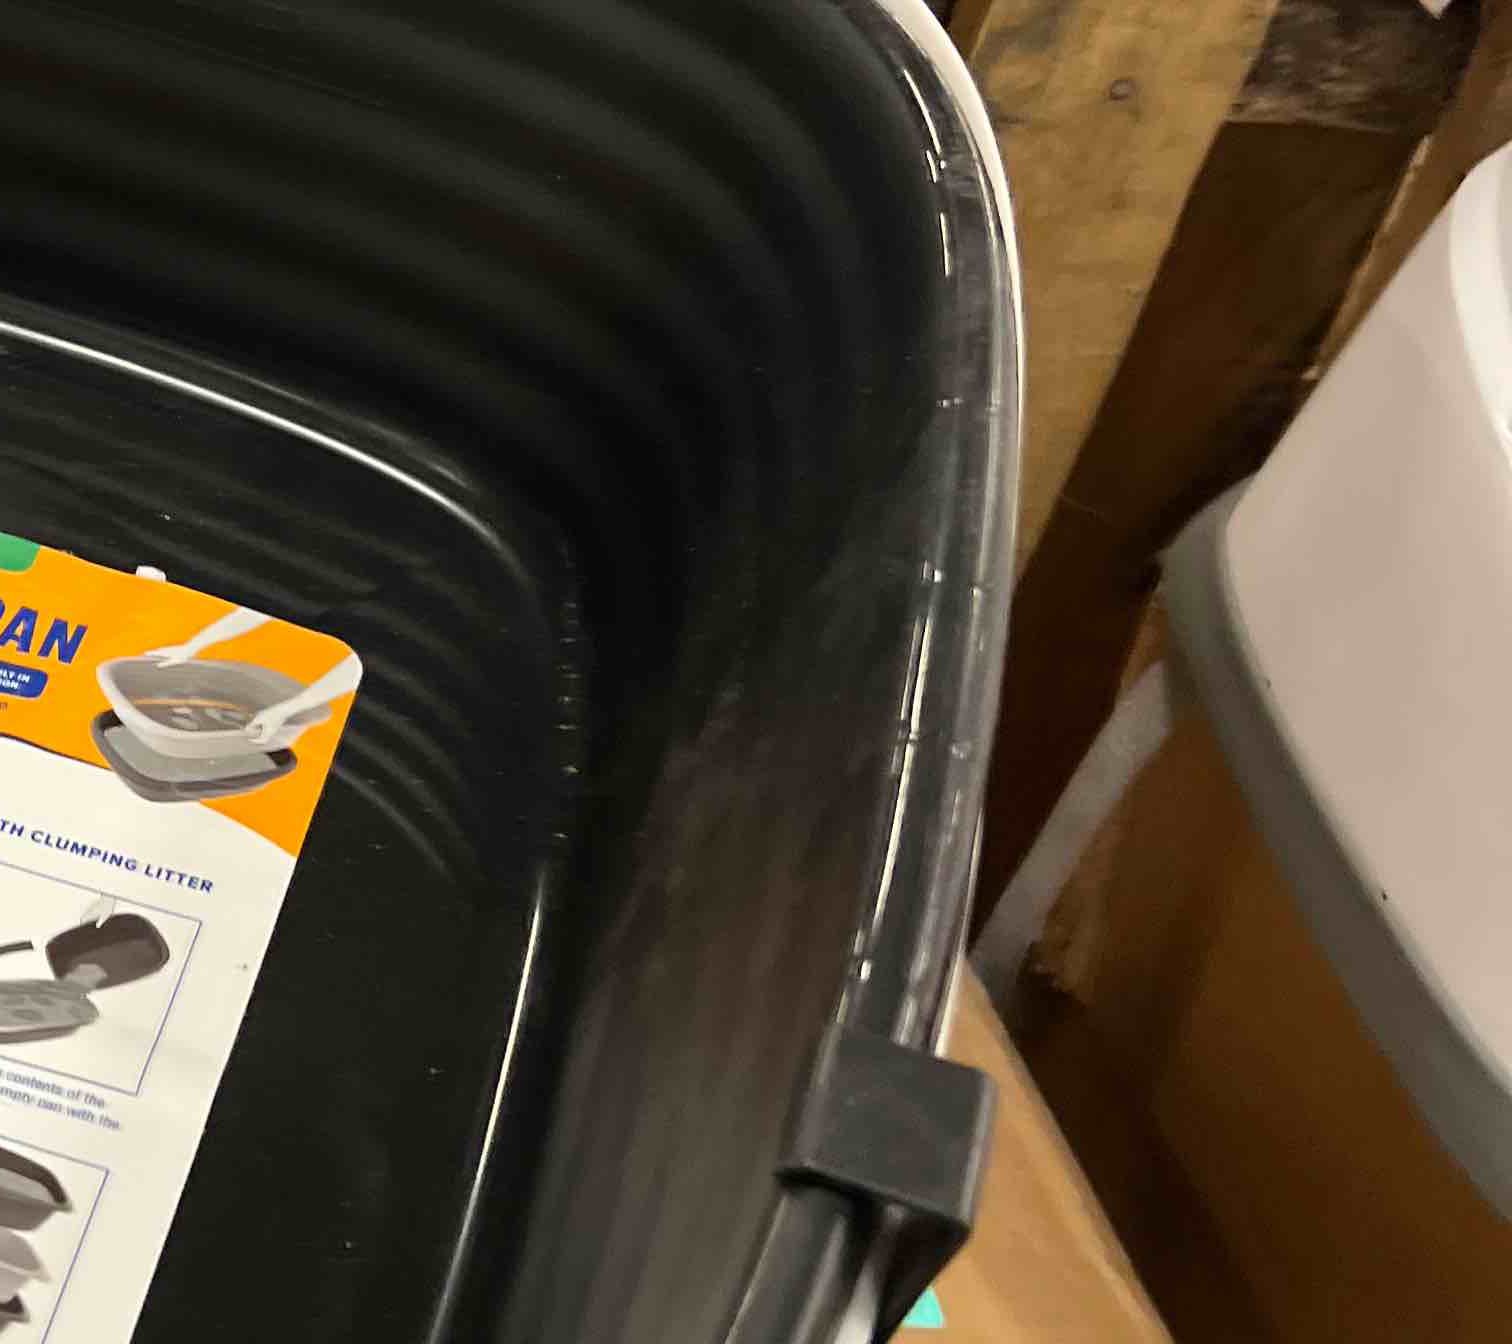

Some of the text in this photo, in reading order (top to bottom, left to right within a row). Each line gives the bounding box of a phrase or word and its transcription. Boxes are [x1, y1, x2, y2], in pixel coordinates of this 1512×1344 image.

[28, 826, 139, 872] CLUMPING
[143, 861, 213, 895] LITTER
[4, 1068, 65, 1097] contents
[82, 1091, 109, 1111] the
[35, 1095, 64, 1115] pan
[64, 1103, 97, 1124] with
[96, 1112, 123, 1132] the
